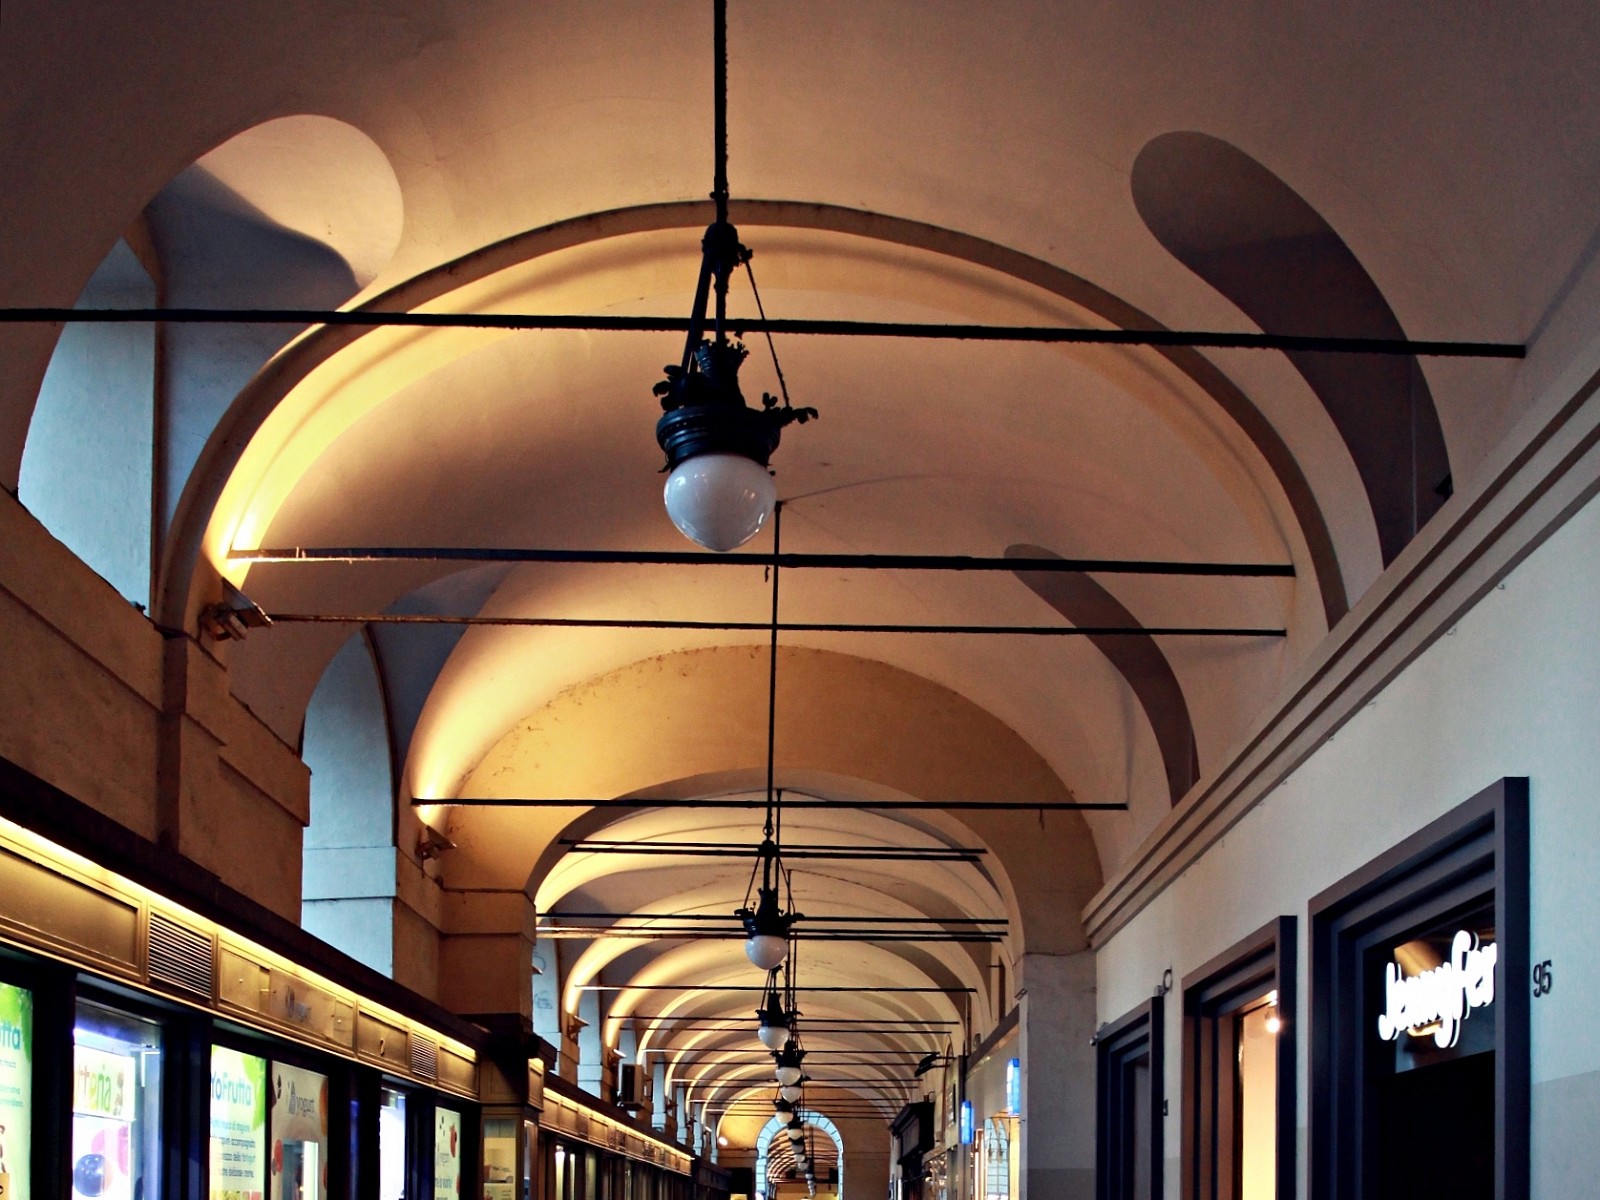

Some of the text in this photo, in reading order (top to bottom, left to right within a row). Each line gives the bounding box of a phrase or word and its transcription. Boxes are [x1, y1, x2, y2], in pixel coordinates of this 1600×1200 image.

[1532, 959, 1552, 998] 95
[0, 1022, 21, 1050] tta
[210, 1070, 252, 1106] YoFrutta
